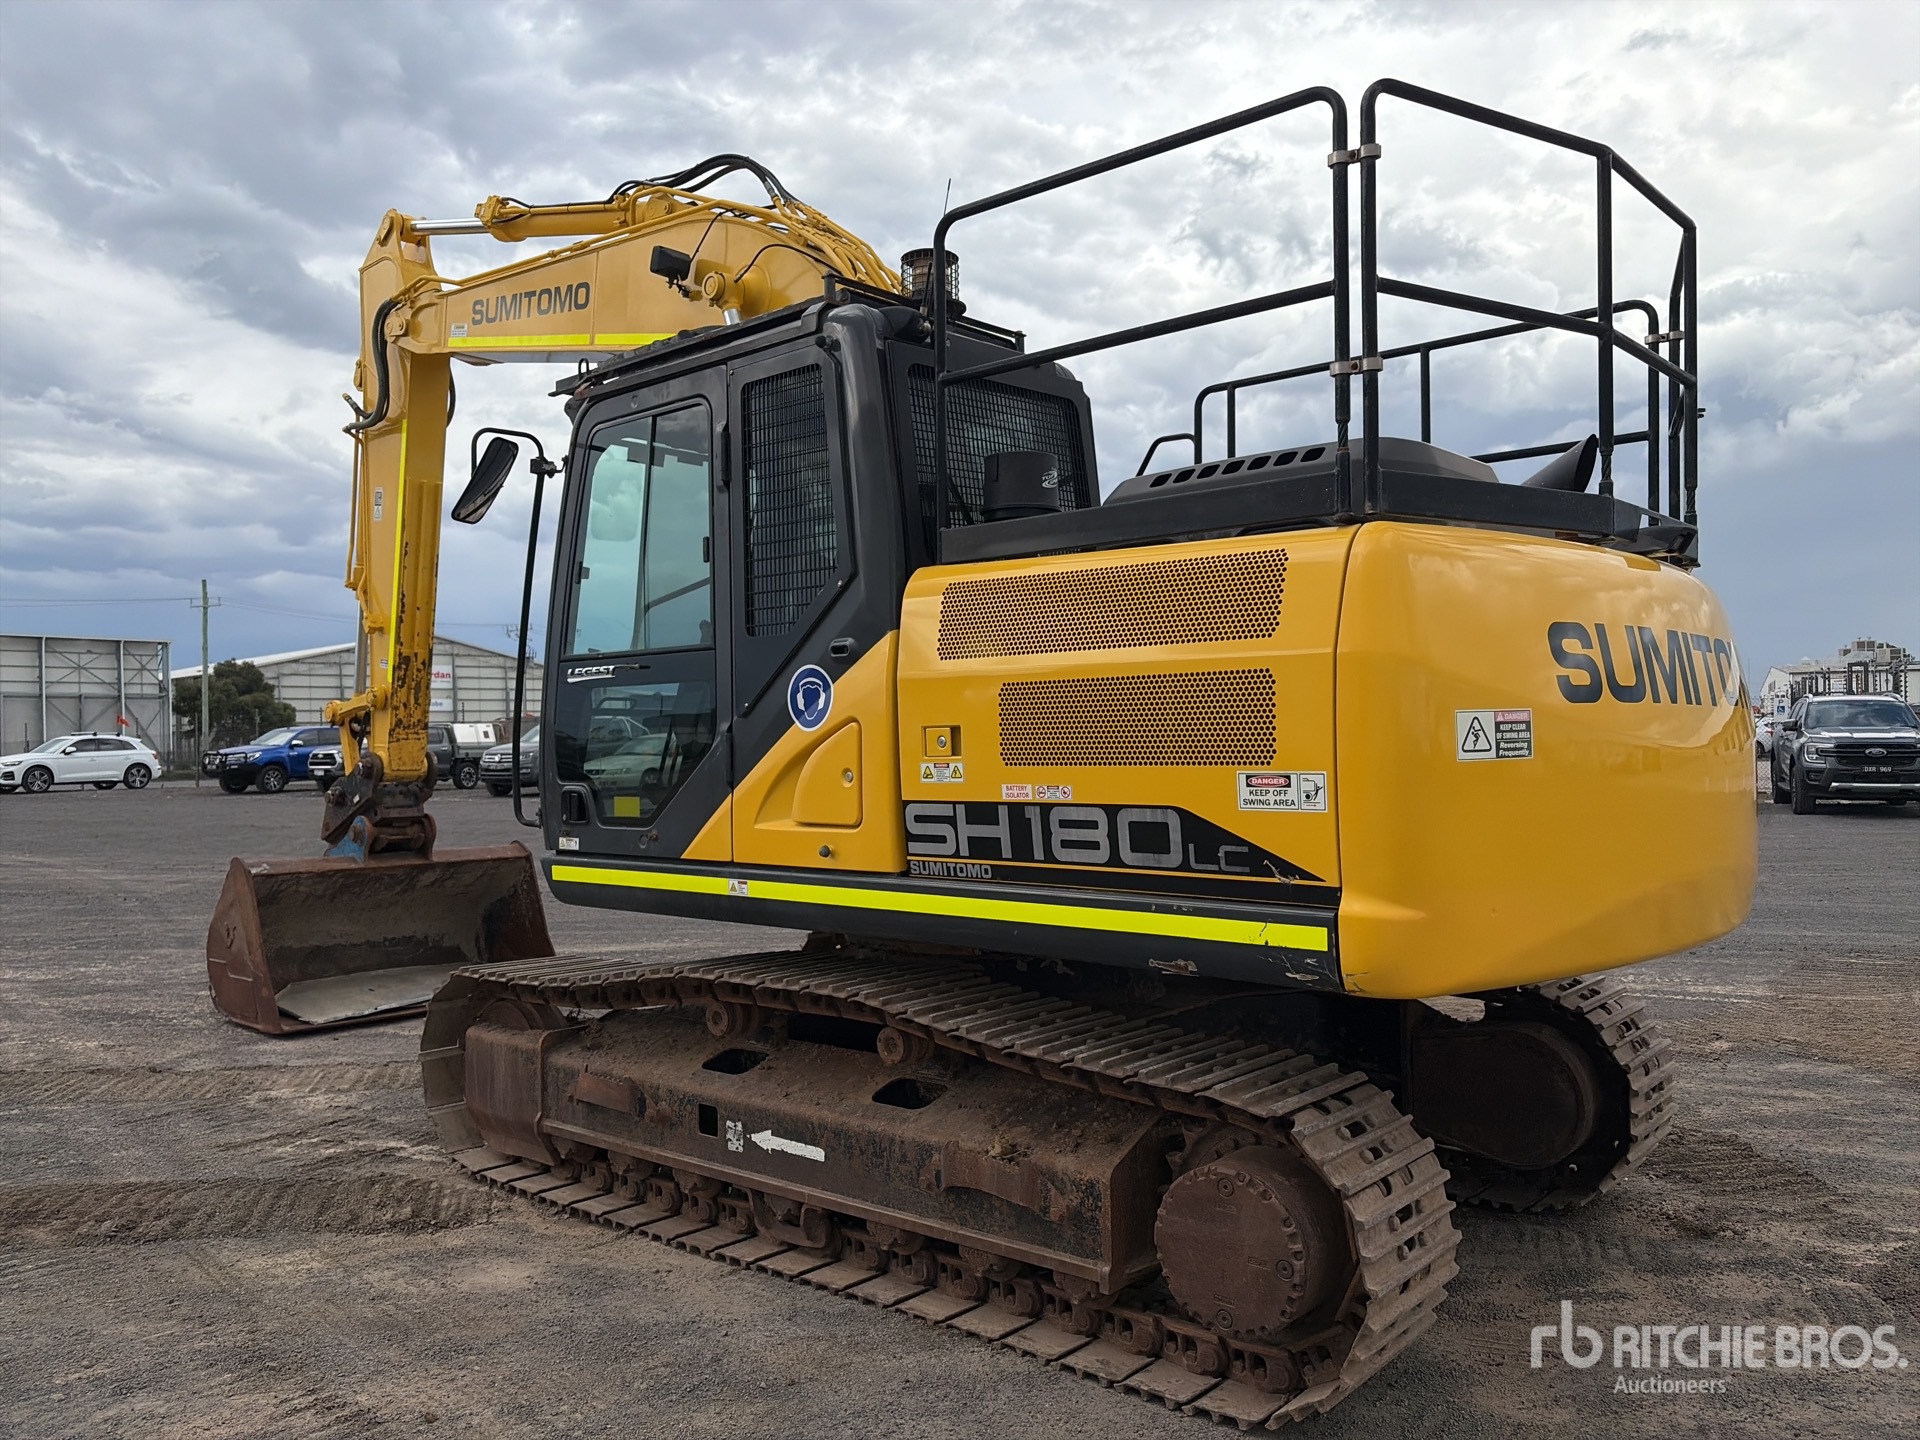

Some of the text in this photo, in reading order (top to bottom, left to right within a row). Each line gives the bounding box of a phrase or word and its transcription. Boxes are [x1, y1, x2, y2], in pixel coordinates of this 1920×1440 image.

[472, 281, 590, 325] SUMITOMO
[1504, 712, 1528, 720] DANGER
[1500, 741, 1528, 749] Reversing
[1499, 749, 1529, 757] Frequently
[1249, 789, 1288, 797] KEEP OFF
[1243, 798, 1296, 807] SWING AREA
[910, 860, 992, 879] SUMITOMO
